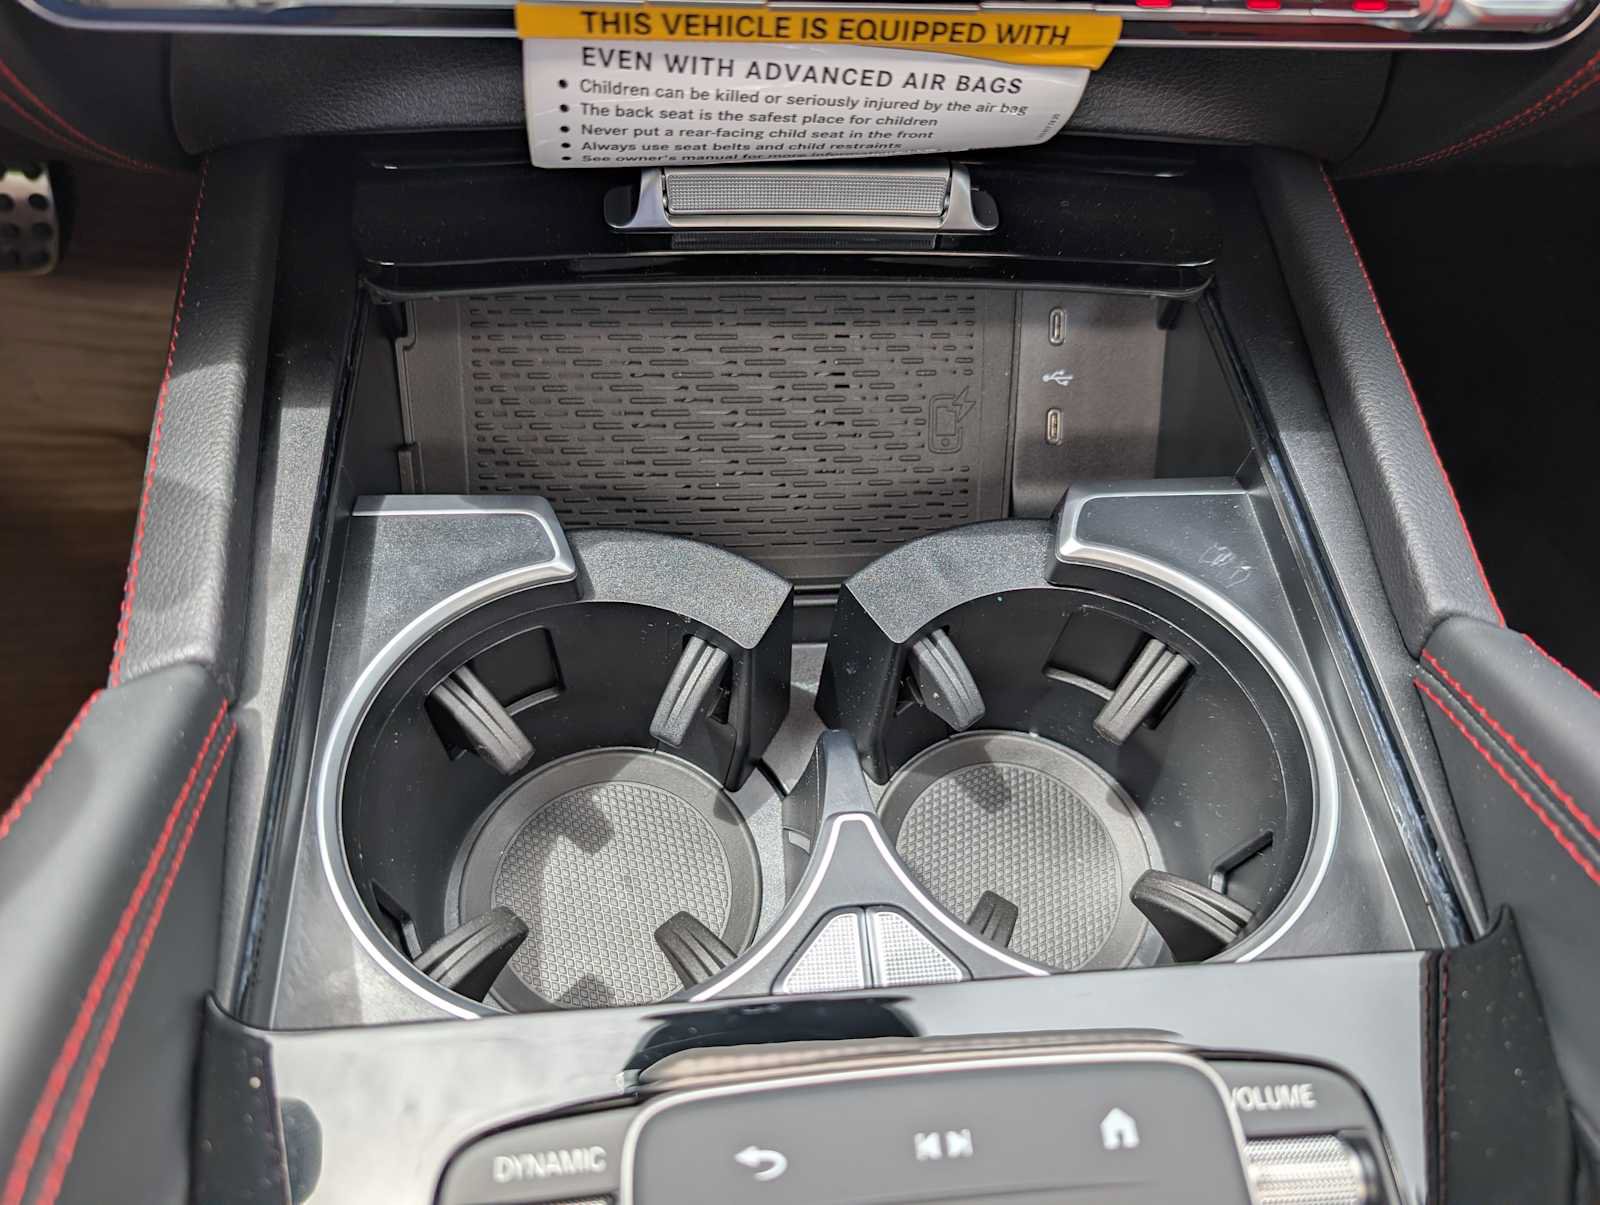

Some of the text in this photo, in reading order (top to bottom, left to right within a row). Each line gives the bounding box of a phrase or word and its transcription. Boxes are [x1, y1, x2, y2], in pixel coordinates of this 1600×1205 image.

[580, 10, 1071, 46] THIS VEHICLE IS EQUIPPED WITH
[581, 46, 1024, 95] EVEN WITH ADVANCED AIR BAGS
[579, 79, 1029, 116] Children can be killed or seriously injured by the air bag
[580, 103, 938, 127] The back seat is the safest place for children
[581, 123, 934, 141] Never put a rear-facing child seat in the front
[581, 142, 903, 152] Always use seat belts and child restraints
[581, 154, 611, 162] See
[615, 154, 677, 162] owner's
[493, 1145, 608, 1183] DYNAMIC
